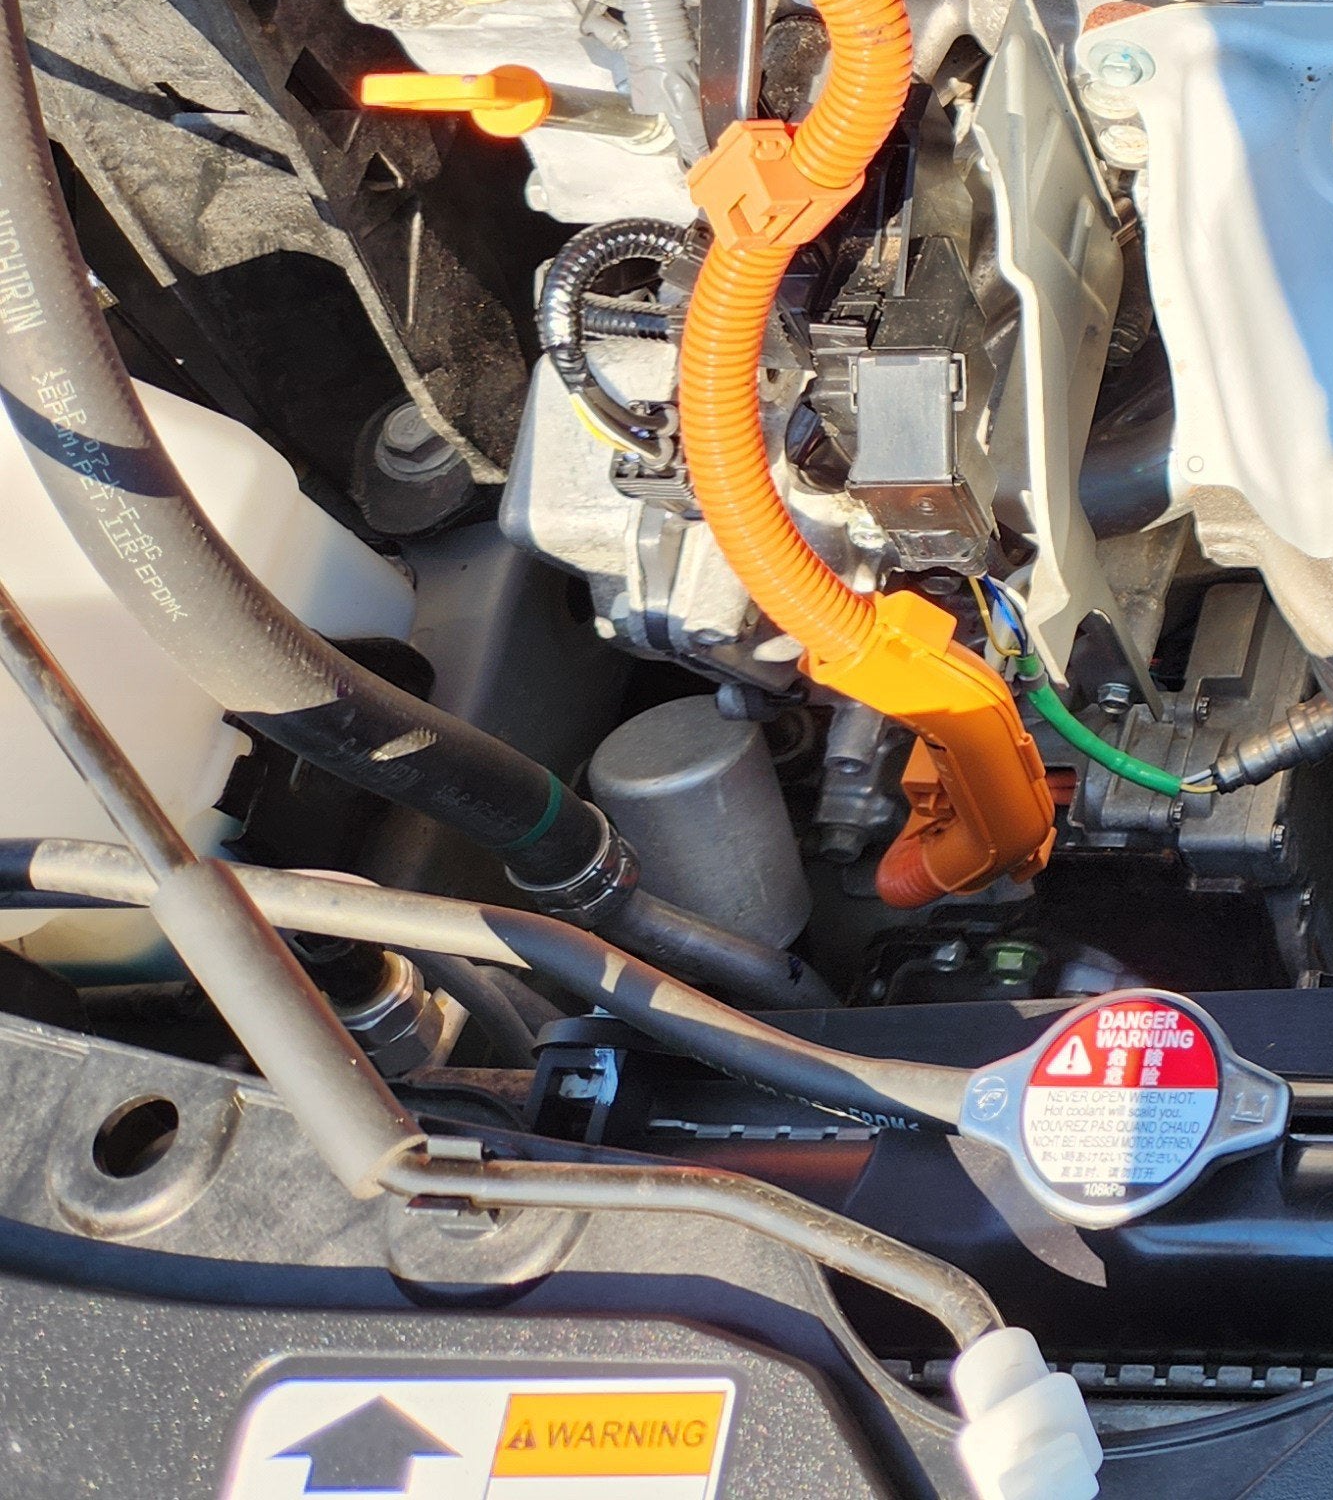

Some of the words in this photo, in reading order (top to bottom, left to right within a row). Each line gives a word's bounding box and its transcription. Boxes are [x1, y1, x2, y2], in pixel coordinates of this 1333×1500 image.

[49, 367, 87, 426] 15LP
[1098, 1010, 1180, 1030] DANGER
[1096, 1029, 1195, 1050] WARNUNG
[1047, 1090, 1088, 1103] NEVER
[1091, 1090, 1125, 1103] OPEN
[1129, 1090, 1165, 1103] WHEN
[1167, 1091, 1196, 1104] HOT.
[1043, 1104, 1063, 1116] Hot
[1090, 1119, 1114, 1132] PAS
[1115, 1119, 1157, 1132] QUAND
[1032, 1135, 1060, 1148] NICHT
[547, 1419, 708, 1450] WARNING
